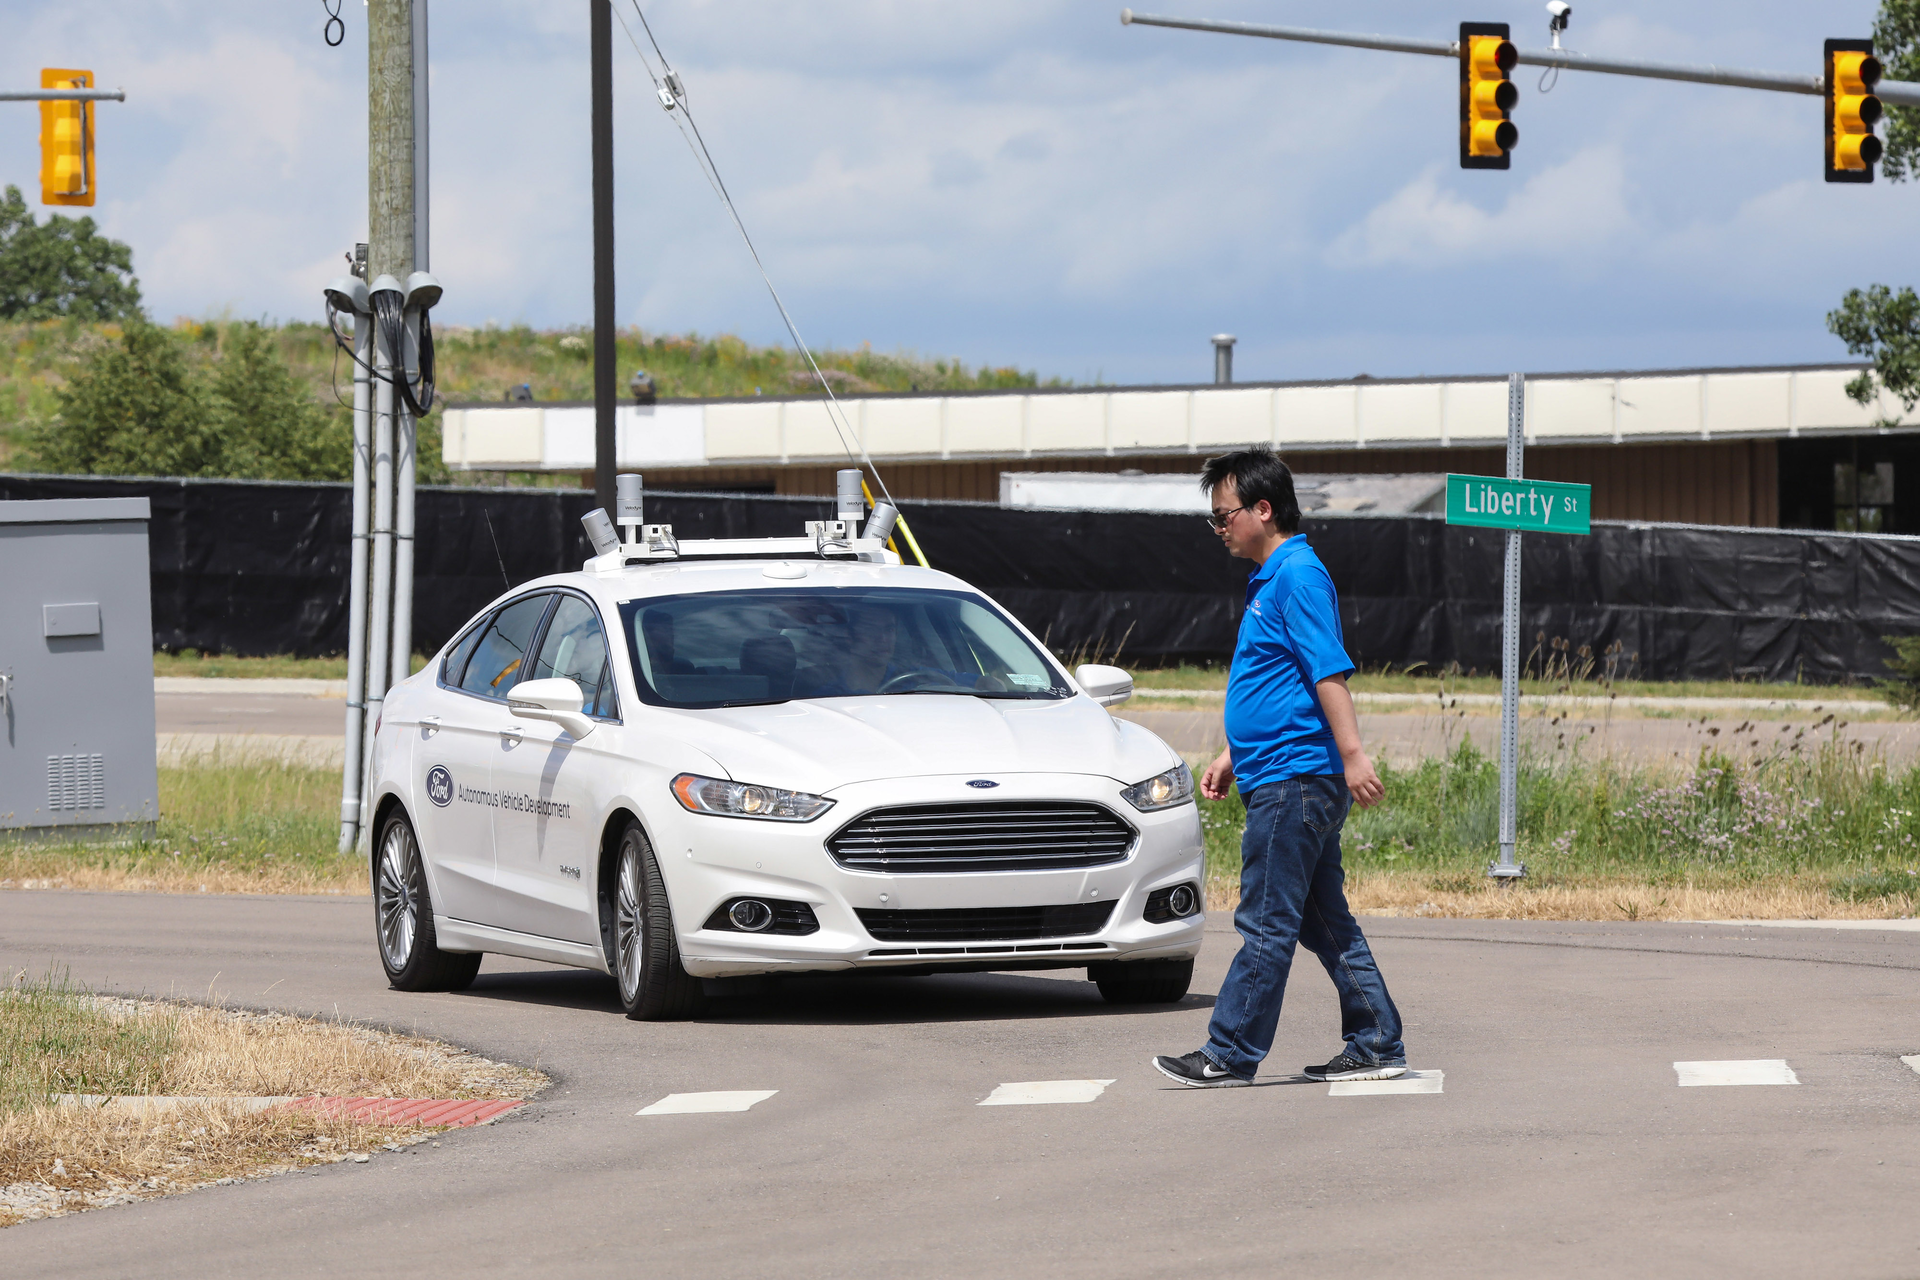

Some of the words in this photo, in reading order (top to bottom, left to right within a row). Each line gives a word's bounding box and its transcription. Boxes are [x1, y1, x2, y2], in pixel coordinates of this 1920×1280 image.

[1465, 483, 1554, 524] Liberty
[1563, 496, 1578, 512] St
[431, 770, 449, 800] Ford
[458, 783, 498, 808] Autonomous
[498, 790, 524, 812] Vehicle
[524, 794, 571, 819] Development
